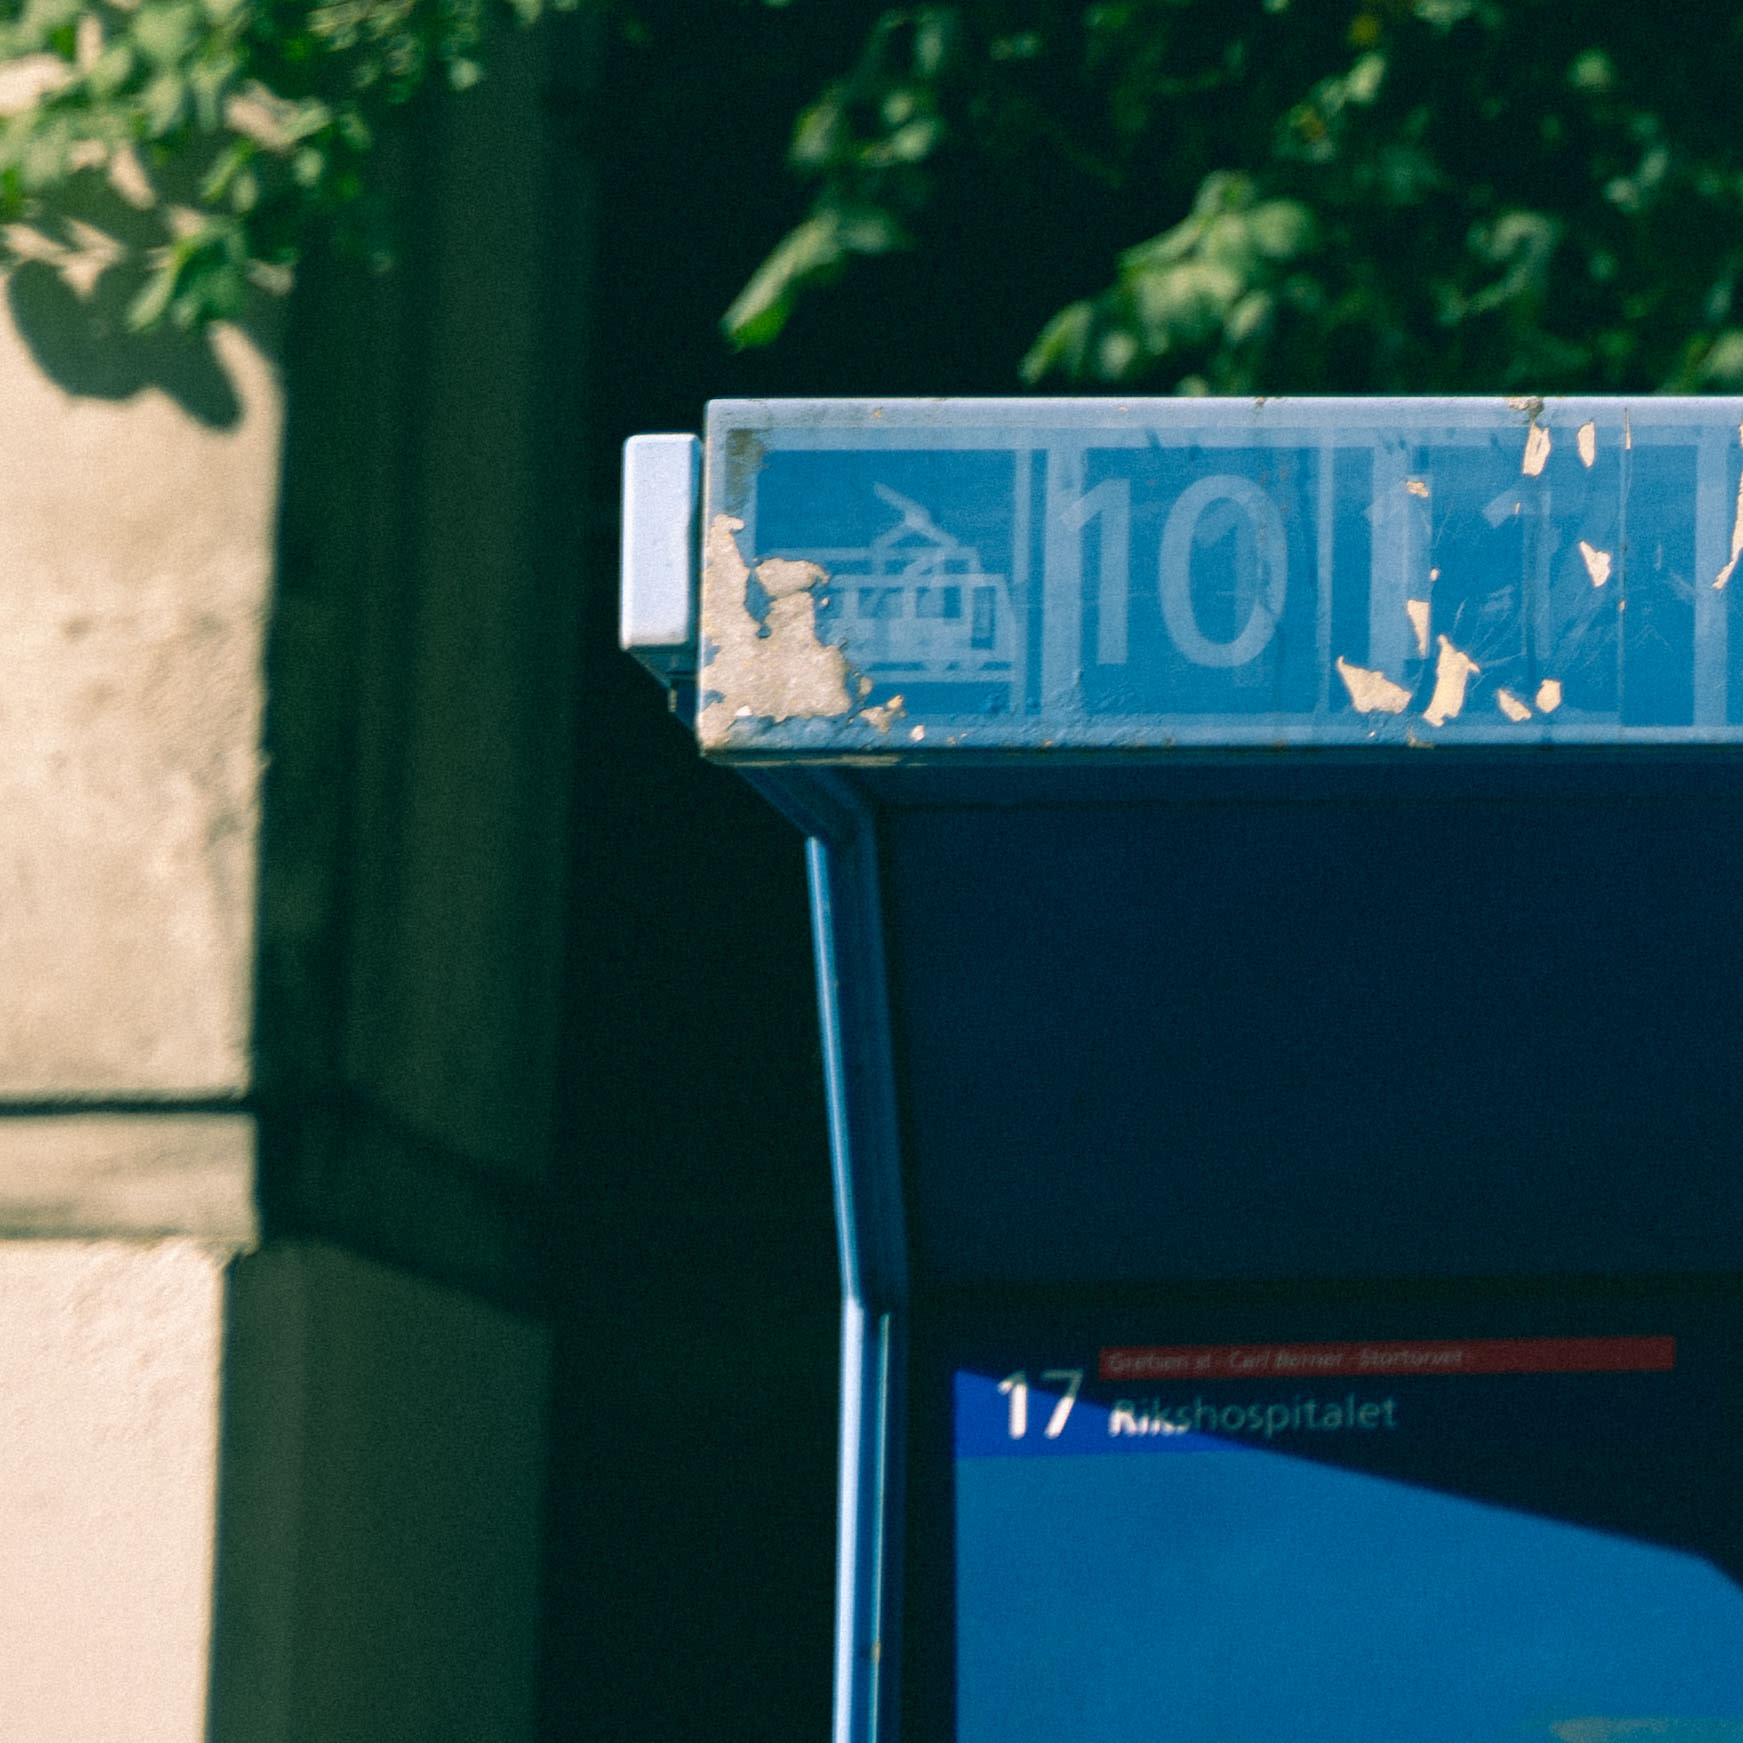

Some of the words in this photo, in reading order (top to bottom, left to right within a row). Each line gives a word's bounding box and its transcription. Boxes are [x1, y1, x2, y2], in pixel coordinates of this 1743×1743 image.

[1061, 474, 1287, 667] 10
[998, 1369, 1083, 1440] 17
[1108, 1394, 1398, 1438] Rikshospitalet
